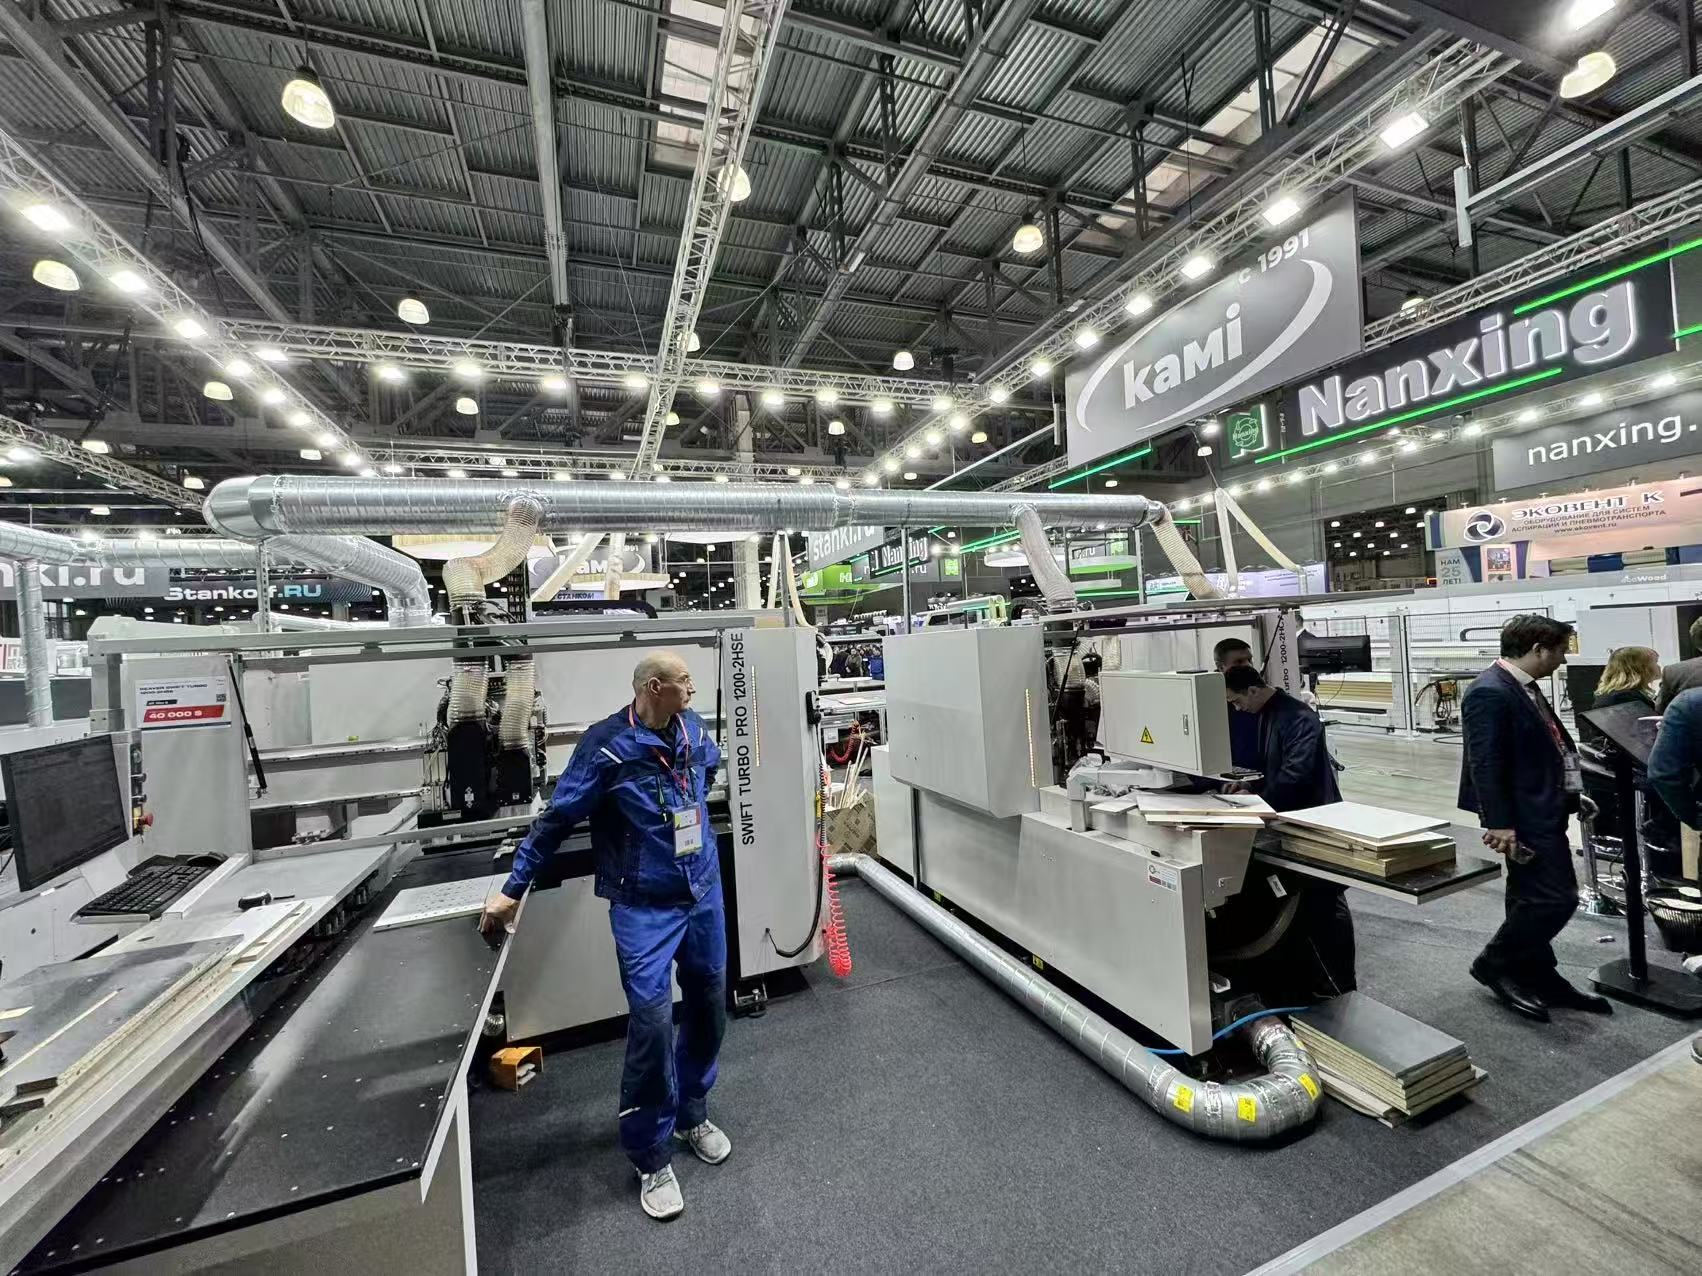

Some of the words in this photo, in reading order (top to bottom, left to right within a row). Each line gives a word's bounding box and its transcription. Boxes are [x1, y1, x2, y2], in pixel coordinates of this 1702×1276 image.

[1256, 227, 1310, 273] 1991
[1298, 280, 1637, 436] Nanxing
[882, 537, 928, 568] Naning
[1440, 558, 1461, 566] НАМ
[1441, 566, 1462, 578] 25
[164, 584, 322, 601] Stankof.RU
[731, 633, 748, 700] 1200-2HSE
[167, 710, 192, 718] 000
[734, 706, 750, 737] PRO
[736, 745, 752, 796] TURBO
[740, 802, 755, 845] SWIFT
